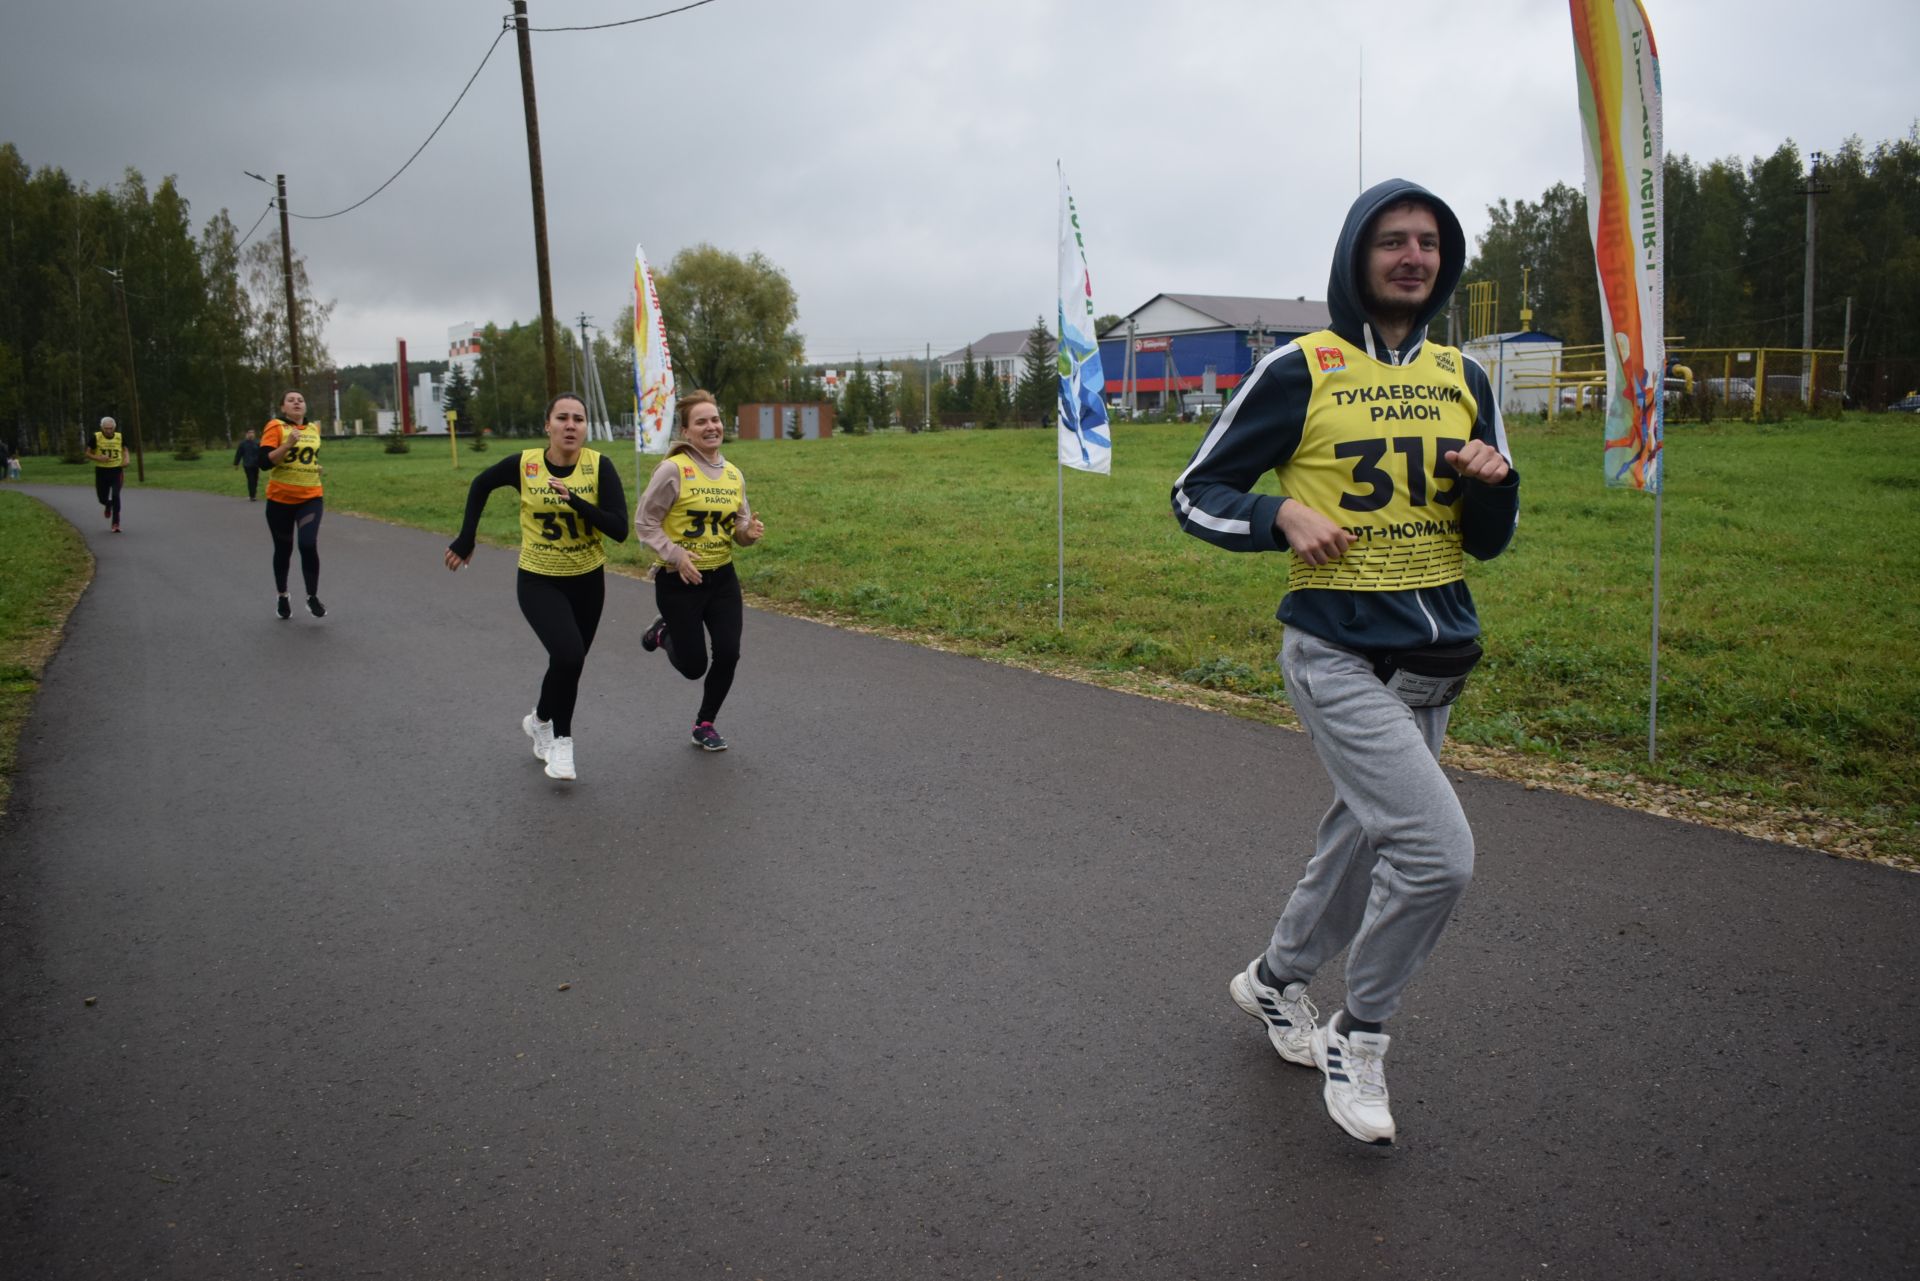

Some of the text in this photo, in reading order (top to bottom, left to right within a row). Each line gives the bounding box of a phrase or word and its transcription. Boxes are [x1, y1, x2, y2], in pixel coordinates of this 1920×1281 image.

[1332, 385, 1462, 406] ТУКАЕВСКИЙ
[1370, 401, 1441, 421] РАЙОН
[1334, 436, 1466, 512] 315
[528, 484, 594, 495] ТУКАСКИЙ
[690, 487, 737, 496] ТУКАЕВСКИЙ
[705, 495, 731, 504] РАЙОН
[1341, 526, 1373, 541] ОРТ
